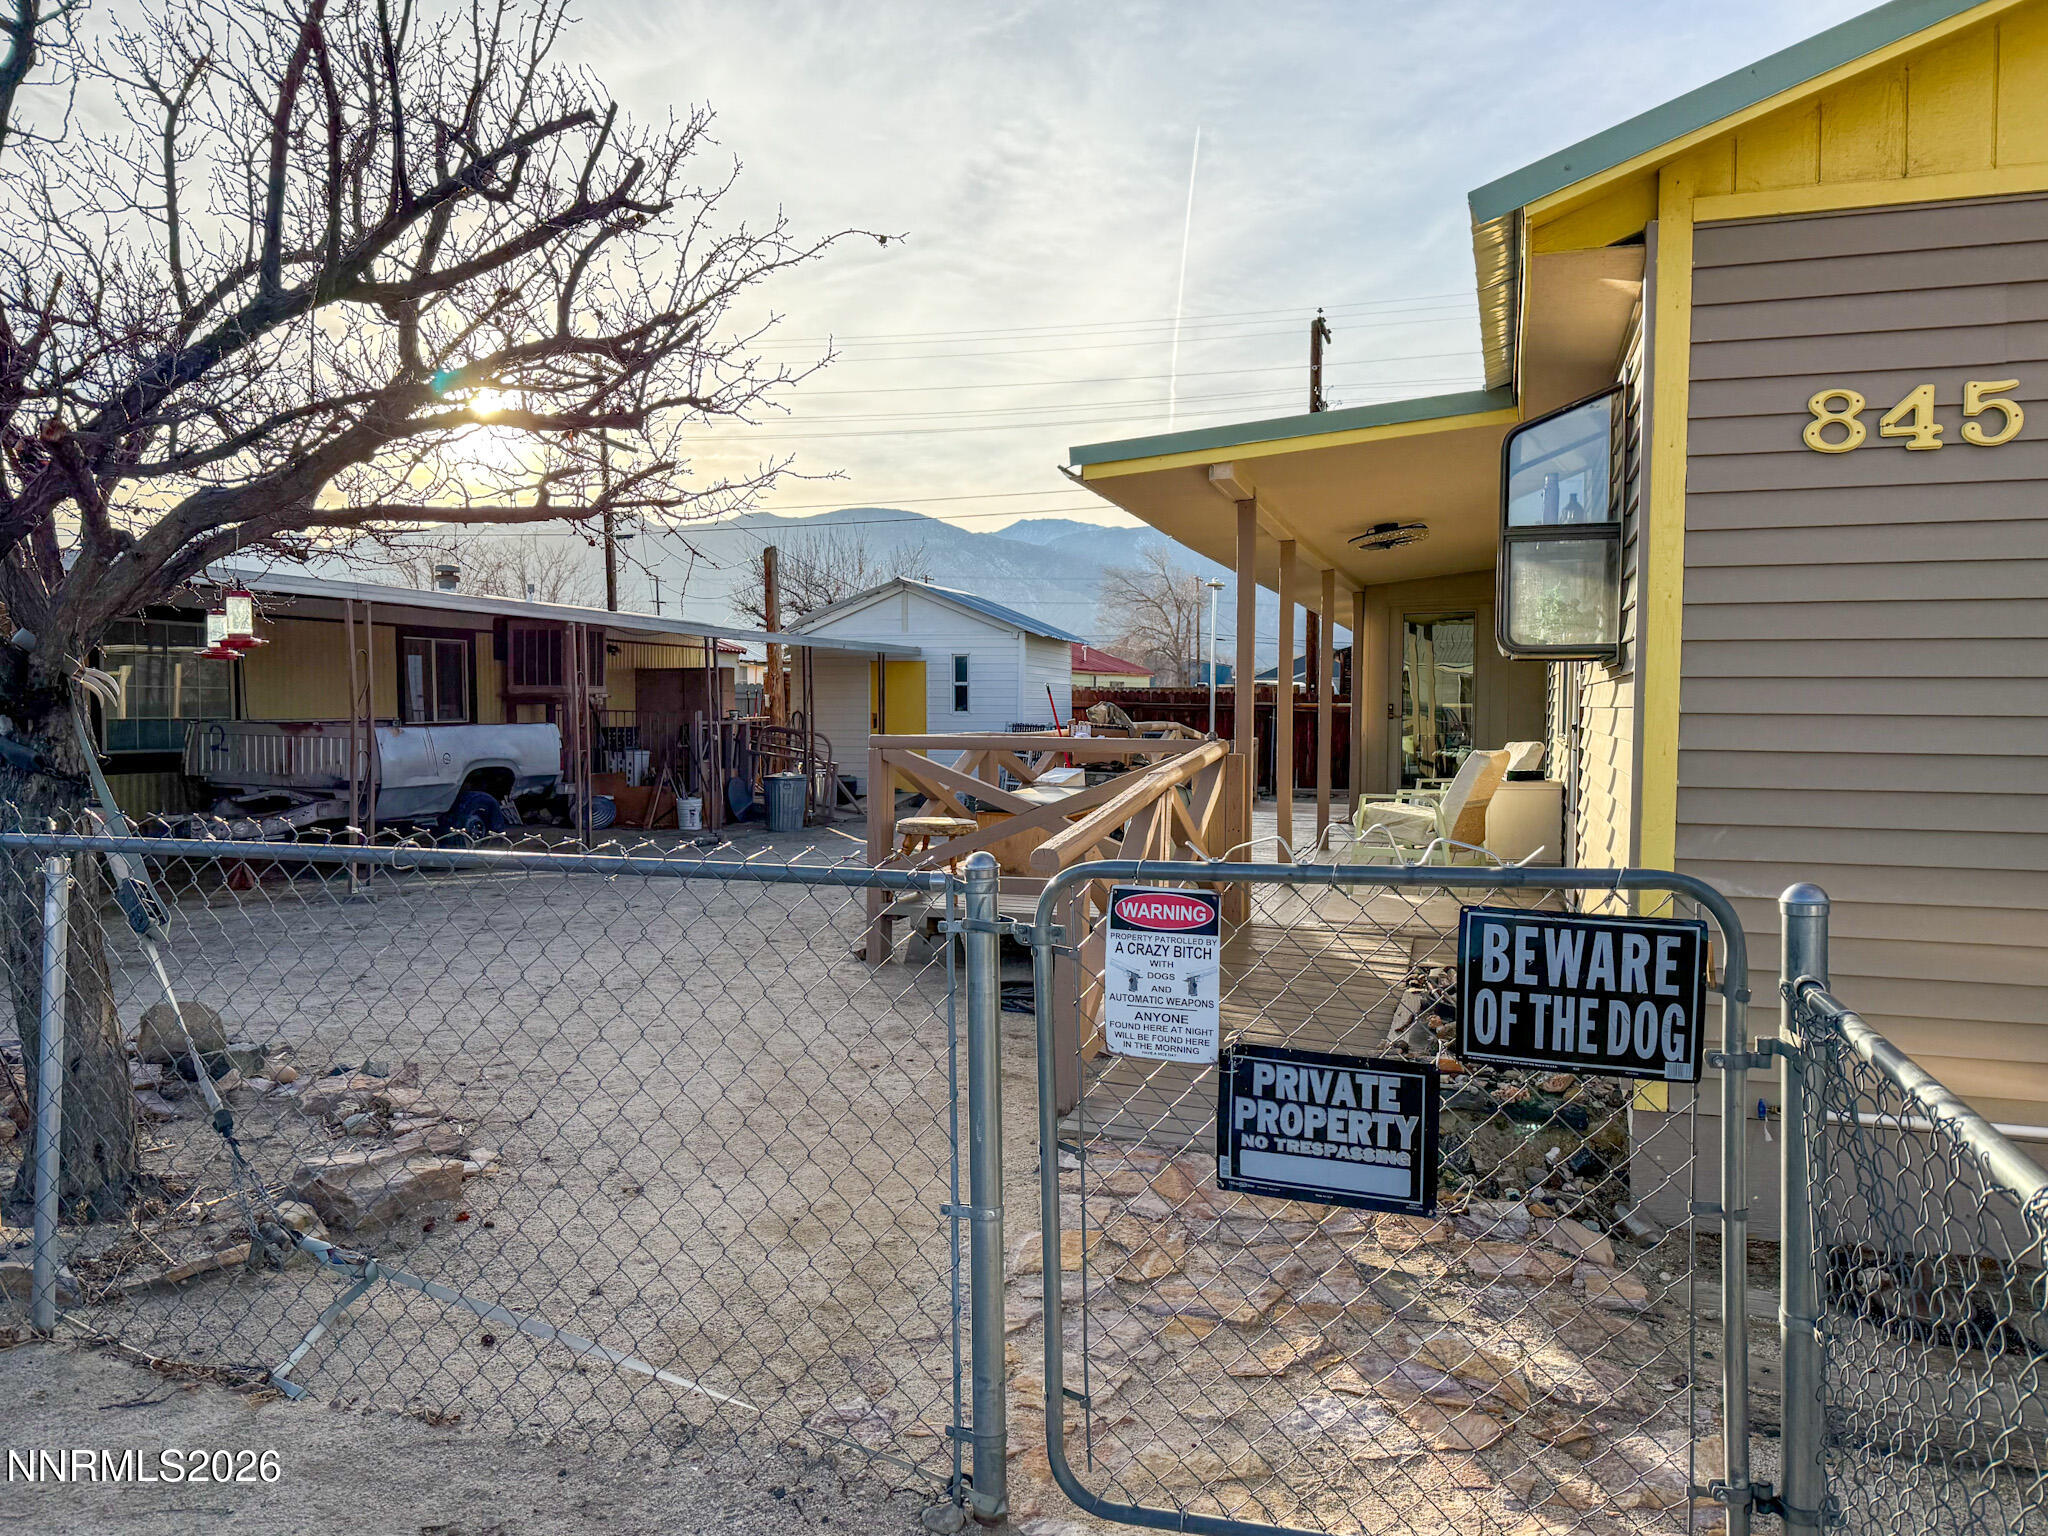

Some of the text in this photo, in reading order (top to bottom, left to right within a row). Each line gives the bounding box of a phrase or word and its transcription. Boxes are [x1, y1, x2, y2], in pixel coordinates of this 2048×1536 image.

[1803, 379, 2024, 453] 845
[1122, 902, 1206, 922] WARNING
[1111, 932, 1152, 941] PROPERTY
[1155, 936, 1203, 945] PATROLLED
[1115, 942, 1212, 960] A CRAZY BITCH
[1150, 960, 1174, 968] WITH
[1482, 923, 1681, 996] BEWARE
[1147, 972, 1175, 980] DOGS
[1109, 993, 1214, 1008] AUTOMATIC WEAPONS
[1135, 1011, 1189, 1024] ANYONE
[1474, 988, 1686, 1062] OF THE DOG
[1110, 1021, 1141, 1030] FOUND
[1144, 1024, 1168, 1032] HERE
[1186, 1028, 1214, 1036] NIGHT
[1114, 1031, 1210, 1046] WILL BE FOUND HERE
[1134, 1042, 1152, 1050] THE
[1155, 1044, 1200, 1055] MORNING
[1253, 1062, 1401, 1112] PRIVATE
[1235, 1096, 1419, 1150] PROPERTY
[1241, 1134, 1411, 1167] NO TRESPASSING
